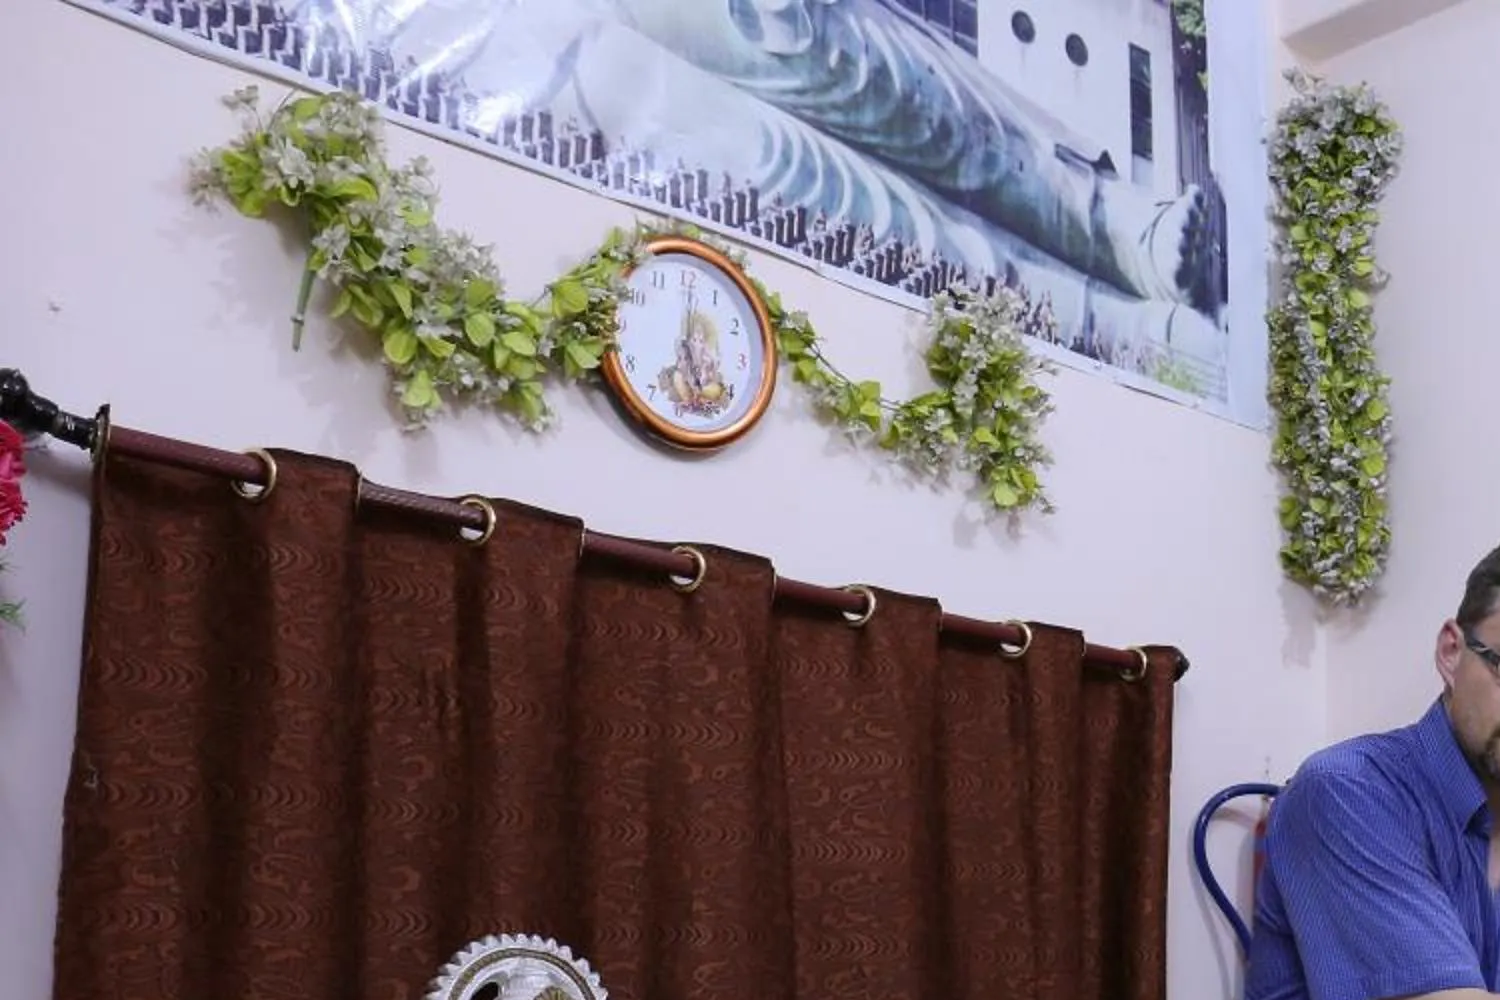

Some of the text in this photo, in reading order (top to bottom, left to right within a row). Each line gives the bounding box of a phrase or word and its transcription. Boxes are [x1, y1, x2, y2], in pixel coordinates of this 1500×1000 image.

[651, 270, 665, 290] 11
[680, 269, 697, 289] 12
[712, 289, 719, 306] 1
[730, 318, 740, 336] 2
[625, 354, 637, 374] 8
[737, 353, 748, 370] 3
[646, 384, 657, 401] 7
